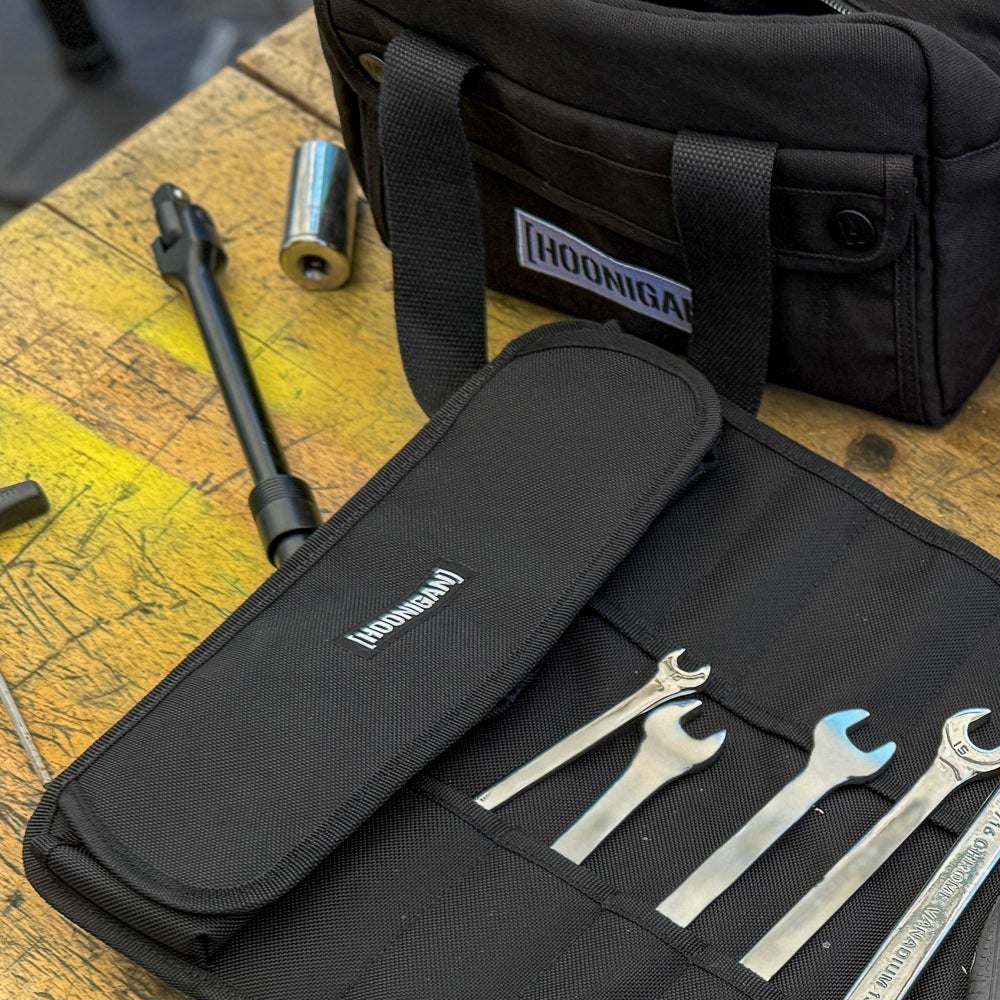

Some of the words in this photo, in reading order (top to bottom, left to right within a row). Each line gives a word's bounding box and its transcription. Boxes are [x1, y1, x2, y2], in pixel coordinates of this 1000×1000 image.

[953, 740, 970, 756] 15
[935, 838, 988, 904] CHROME
[875, 906, 942, 989] VANADIUM
